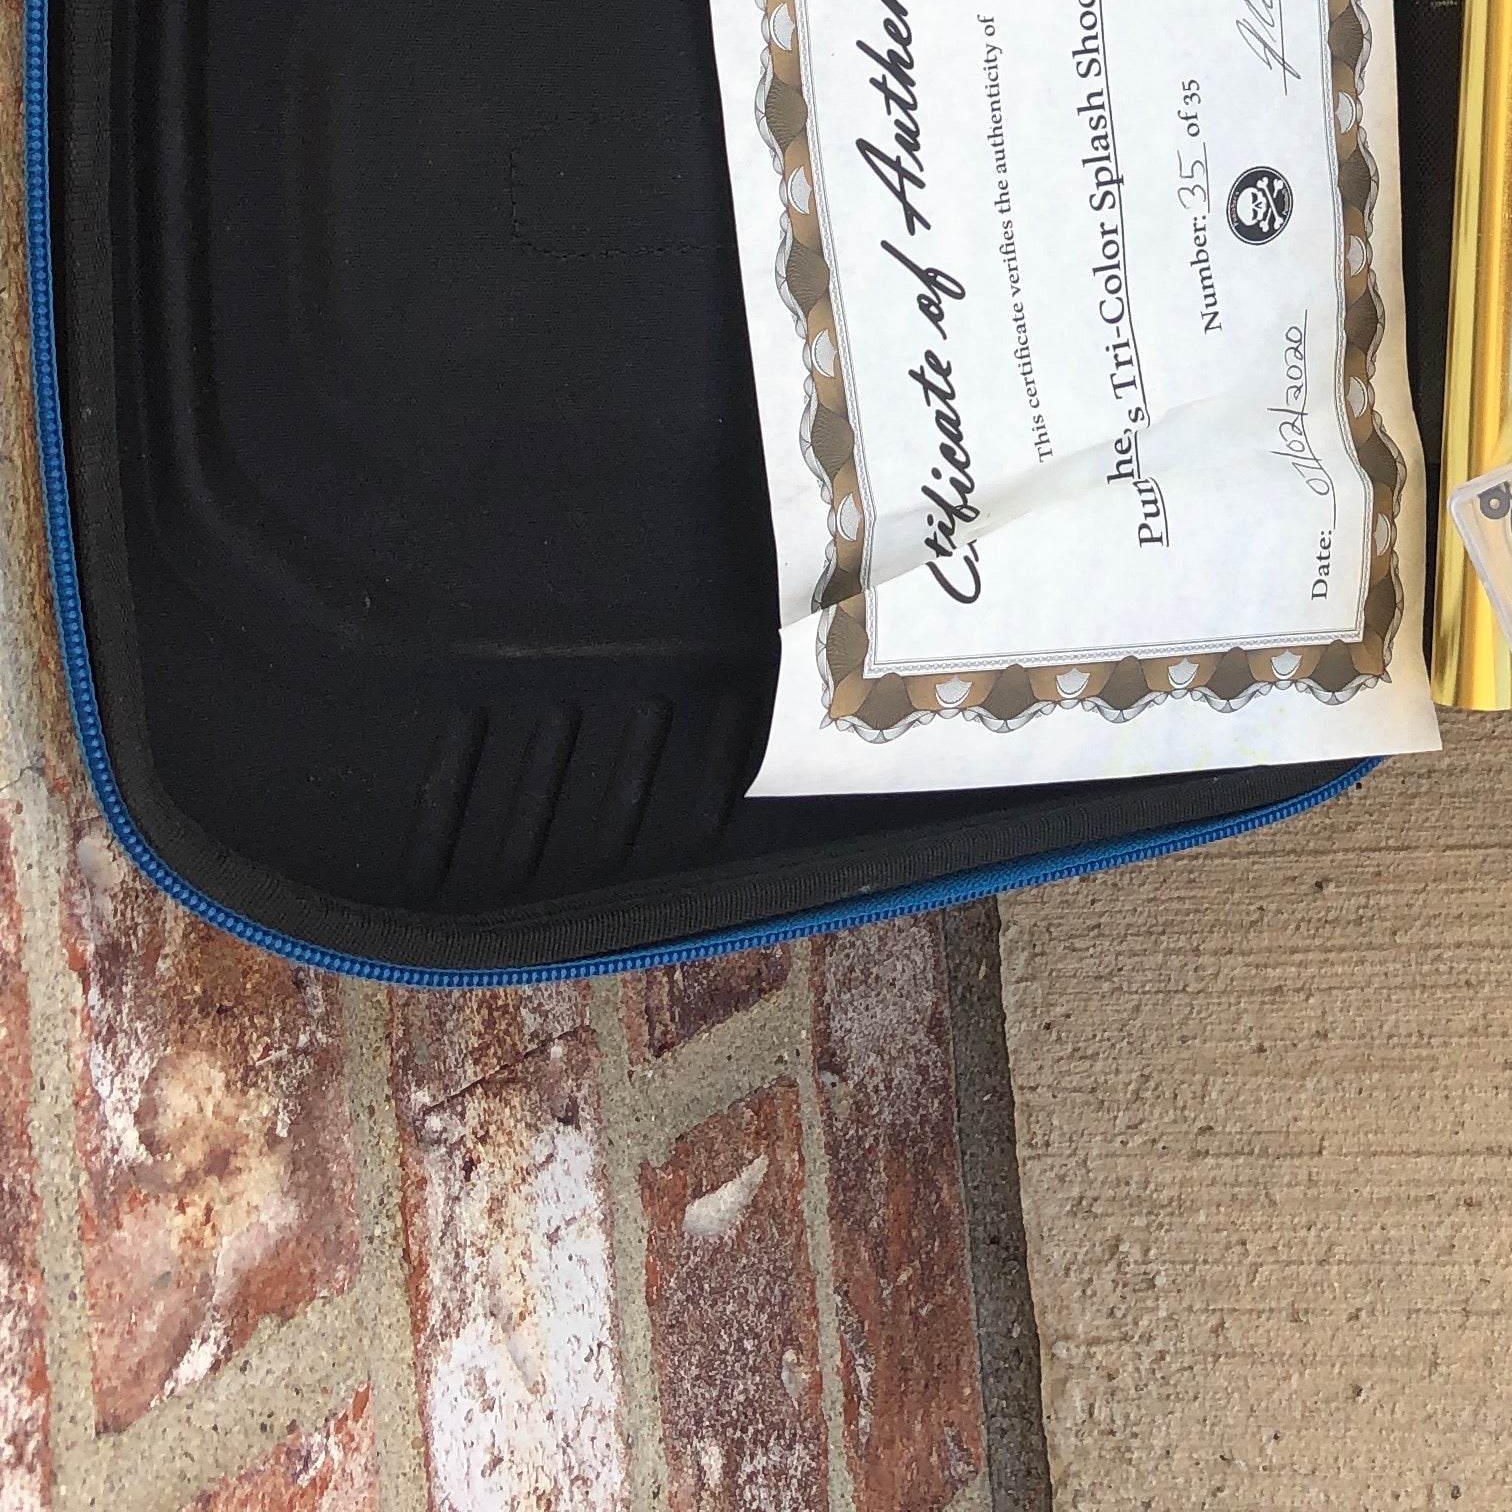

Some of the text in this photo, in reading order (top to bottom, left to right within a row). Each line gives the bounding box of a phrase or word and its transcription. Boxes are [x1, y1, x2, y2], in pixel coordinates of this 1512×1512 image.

[977, 13, 1054, 463] This certificate verifies the authenticity of
[1076, 89, 1124, 211] Splash
[1177, 79, 1223, 334] Number: 35 of 35
[880, 240, 964, 340] of
[1092, 222, 1137, 399] Tri-Color
[908, 349, 981, 604] Ctificate
[1311, 530, 1333, 600] Date:
